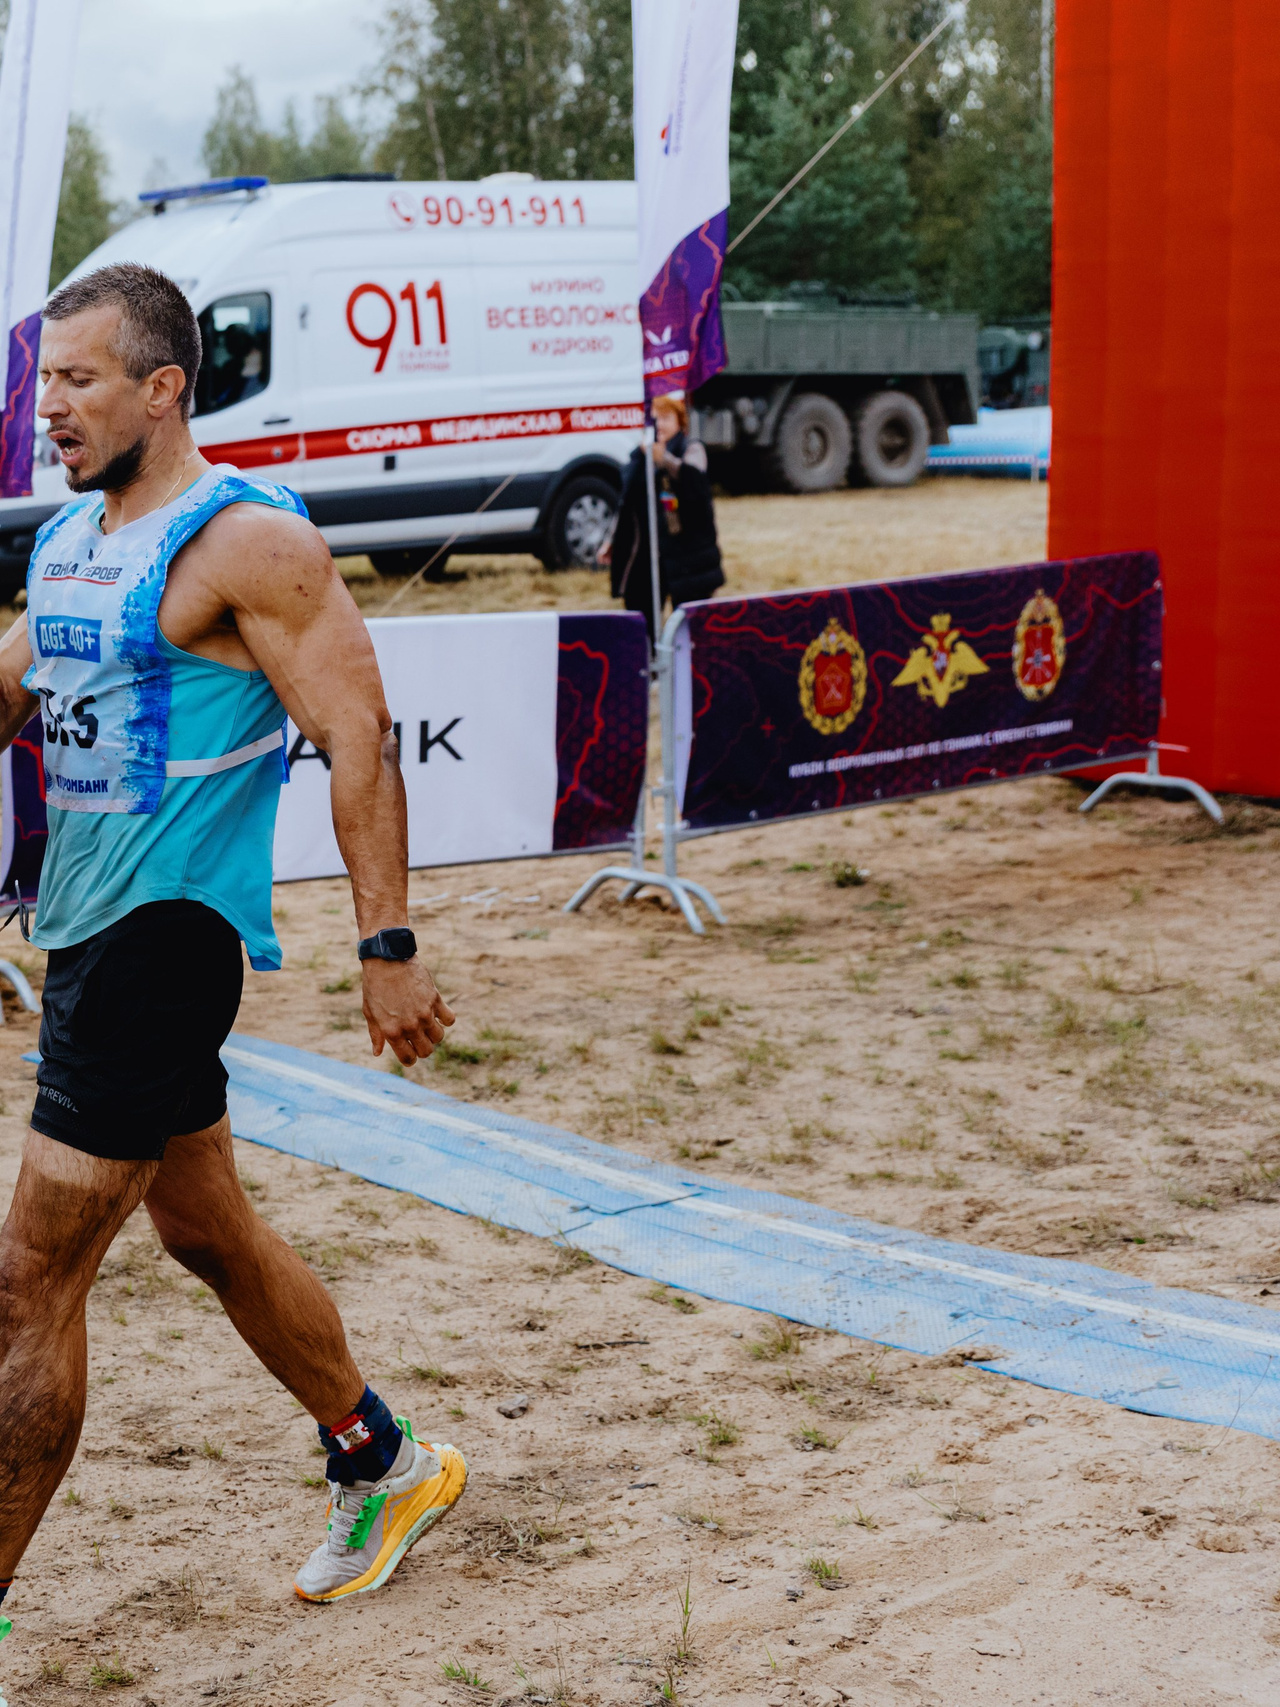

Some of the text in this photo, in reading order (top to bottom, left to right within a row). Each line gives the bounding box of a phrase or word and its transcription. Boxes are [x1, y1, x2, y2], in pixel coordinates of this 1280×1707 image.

[423, 195, 586, 226] 90-91-911
[345, 280, 447, 374] 911
[486, 304, 639, 329] ВСЕВОЛОЖС
[346, 423, 422, 451] СКОРАЯ
[40, 622, 96, 653] AGE 40+
